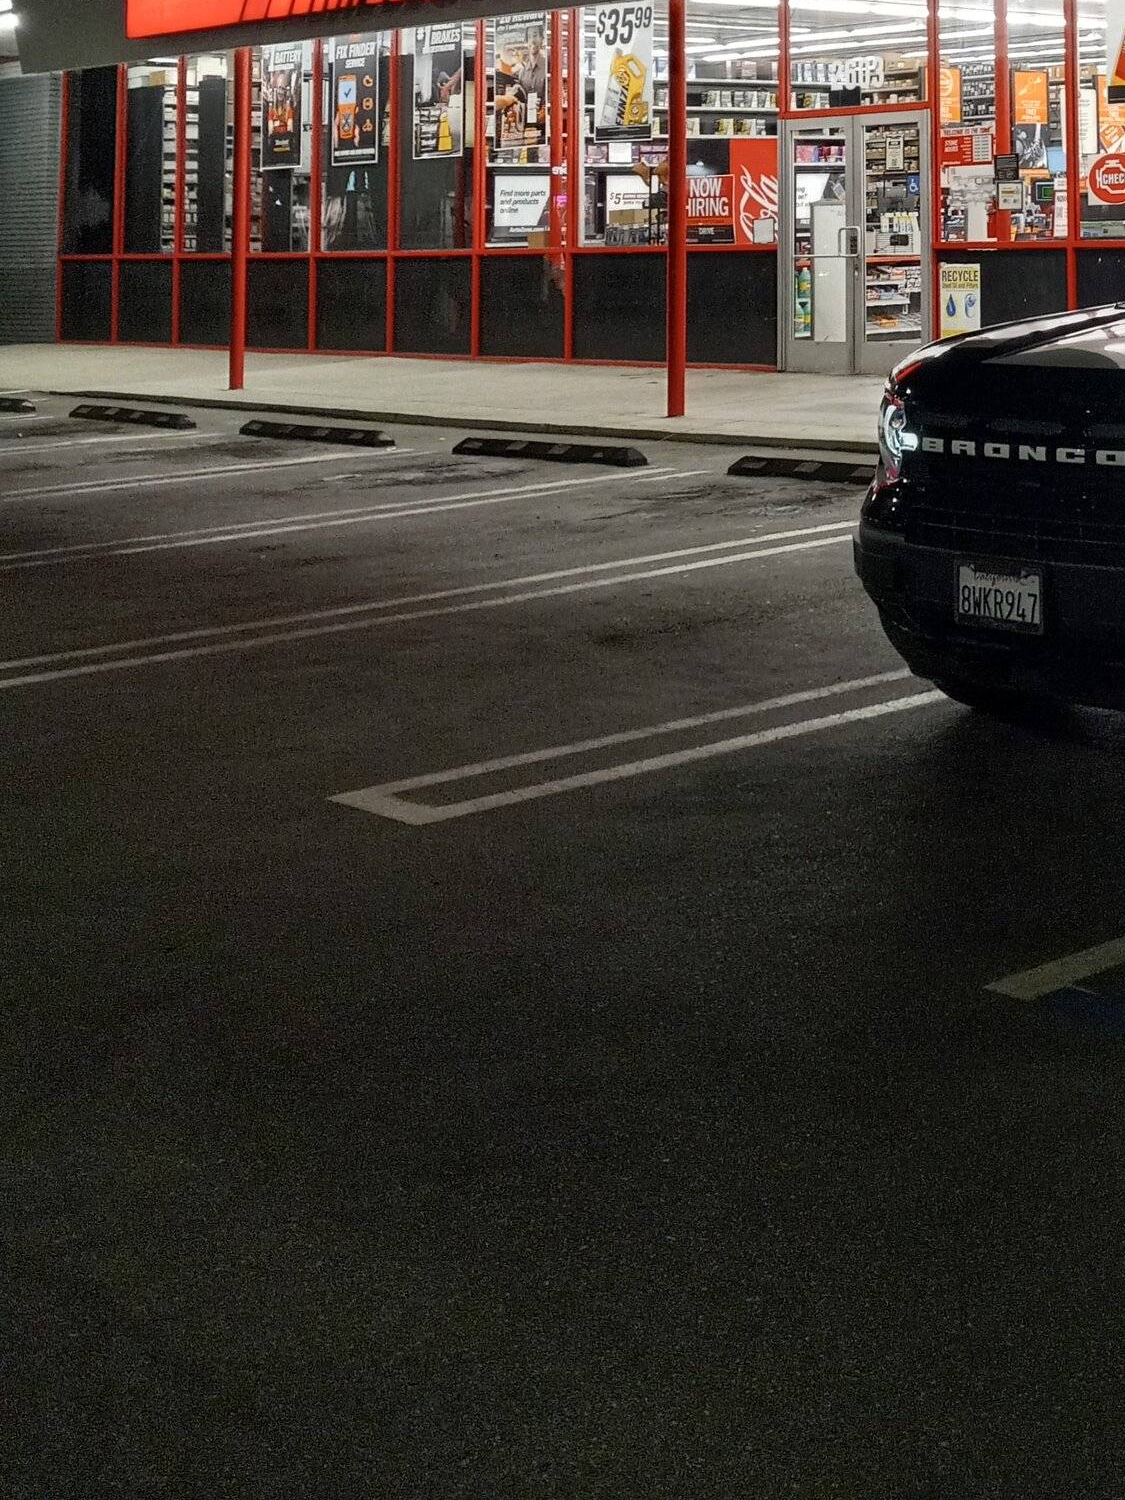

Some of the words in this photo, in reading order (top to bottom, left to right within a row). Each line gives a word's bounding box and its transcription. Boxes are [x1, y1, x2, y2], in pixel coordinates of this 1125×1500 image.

[431, 29, 461, 45] BRAKES
[274, 50, 302, 64] BATTERY
[530, 190, 546, 198] parts
[690, 178, 722, 197] NOW
[513, 198, 539, 206] products
[610, 192, 621, 204] $5
[942, 270, 978, 282] RECYCLE
[962, 585, 1037, 622] 8WKR947
